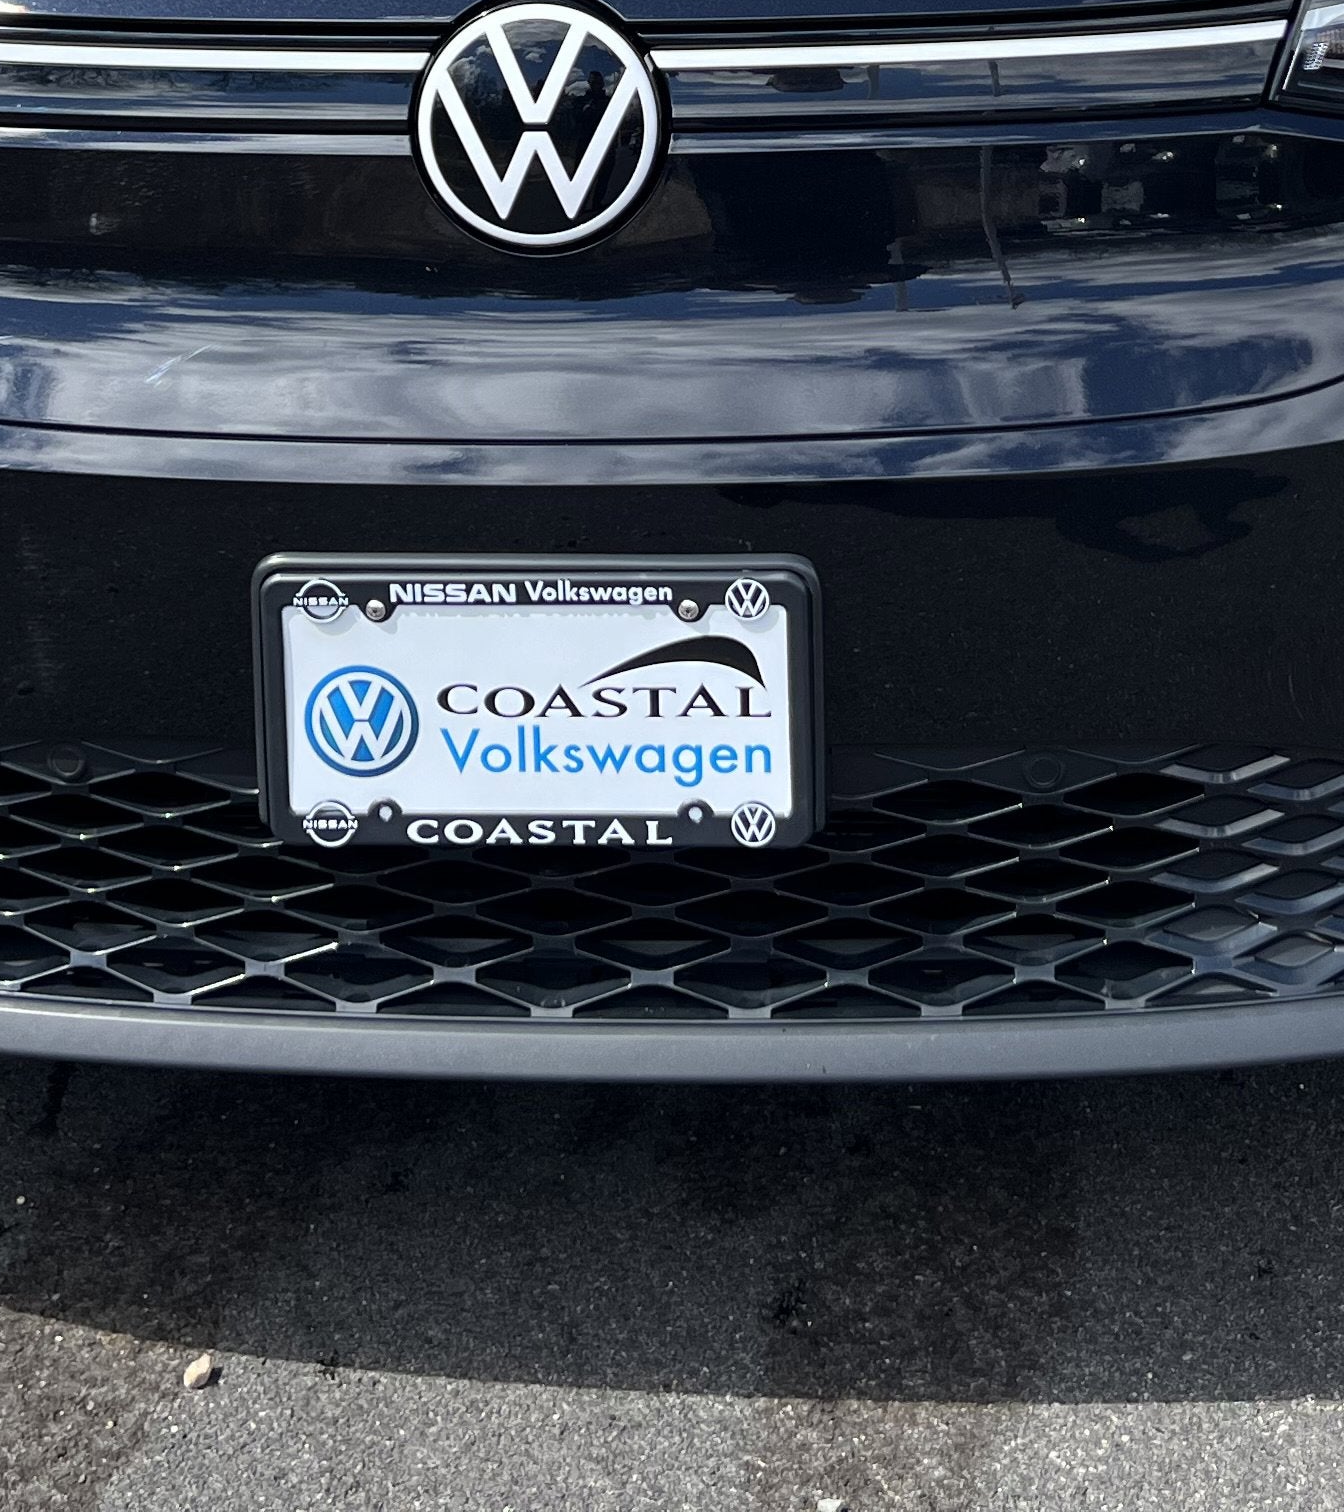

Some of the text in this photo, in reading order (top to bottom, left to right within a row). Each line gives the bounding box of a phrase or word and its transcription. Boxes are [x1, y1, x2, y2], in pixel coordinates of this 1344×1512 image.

[420, 6, 654, 242] VW
[293, 597, 349, 606] NISSAN
[389, 579, 673, 605] NISSAN Volkswagen
[725, 579, 769, 620] VW
[436, 684, 772, 718] COASTAL
[305, 665, 419, 777] VW
[440, 725, 773, 788] Volkswagen
[303, 819, 358, 829] NISSAN
[407, 818, 673, 846] COASTAL
[731, 804, 775, 846] VW
